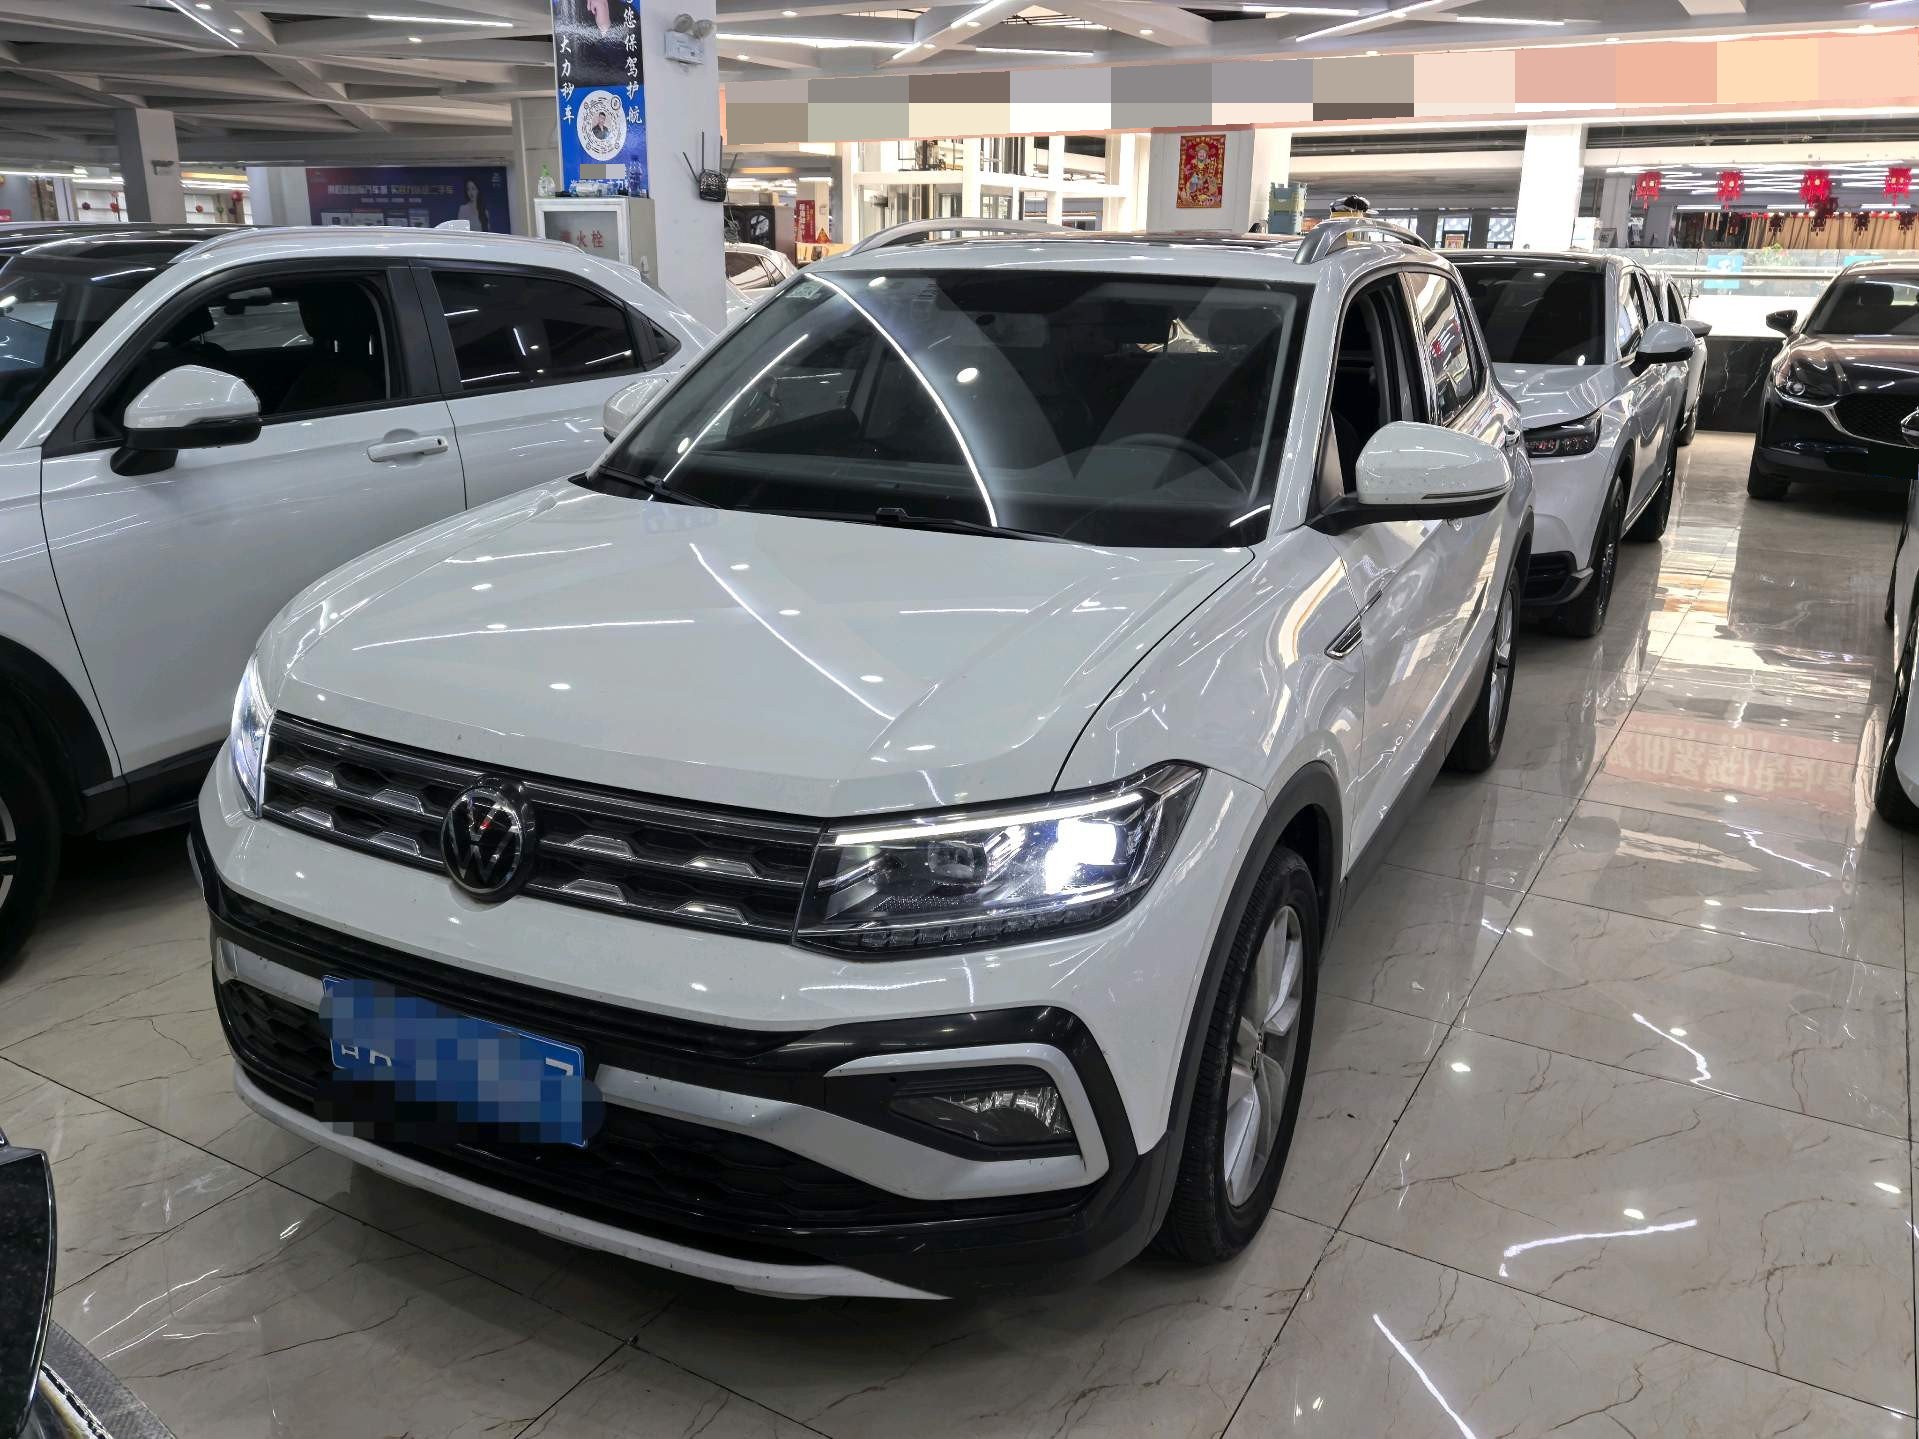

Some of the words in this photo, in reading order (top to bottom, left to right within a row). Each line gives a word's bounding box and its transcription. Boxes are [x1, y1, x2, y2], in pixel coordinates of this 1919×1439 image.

[623, 0, 643, 124] 您保驾护航
